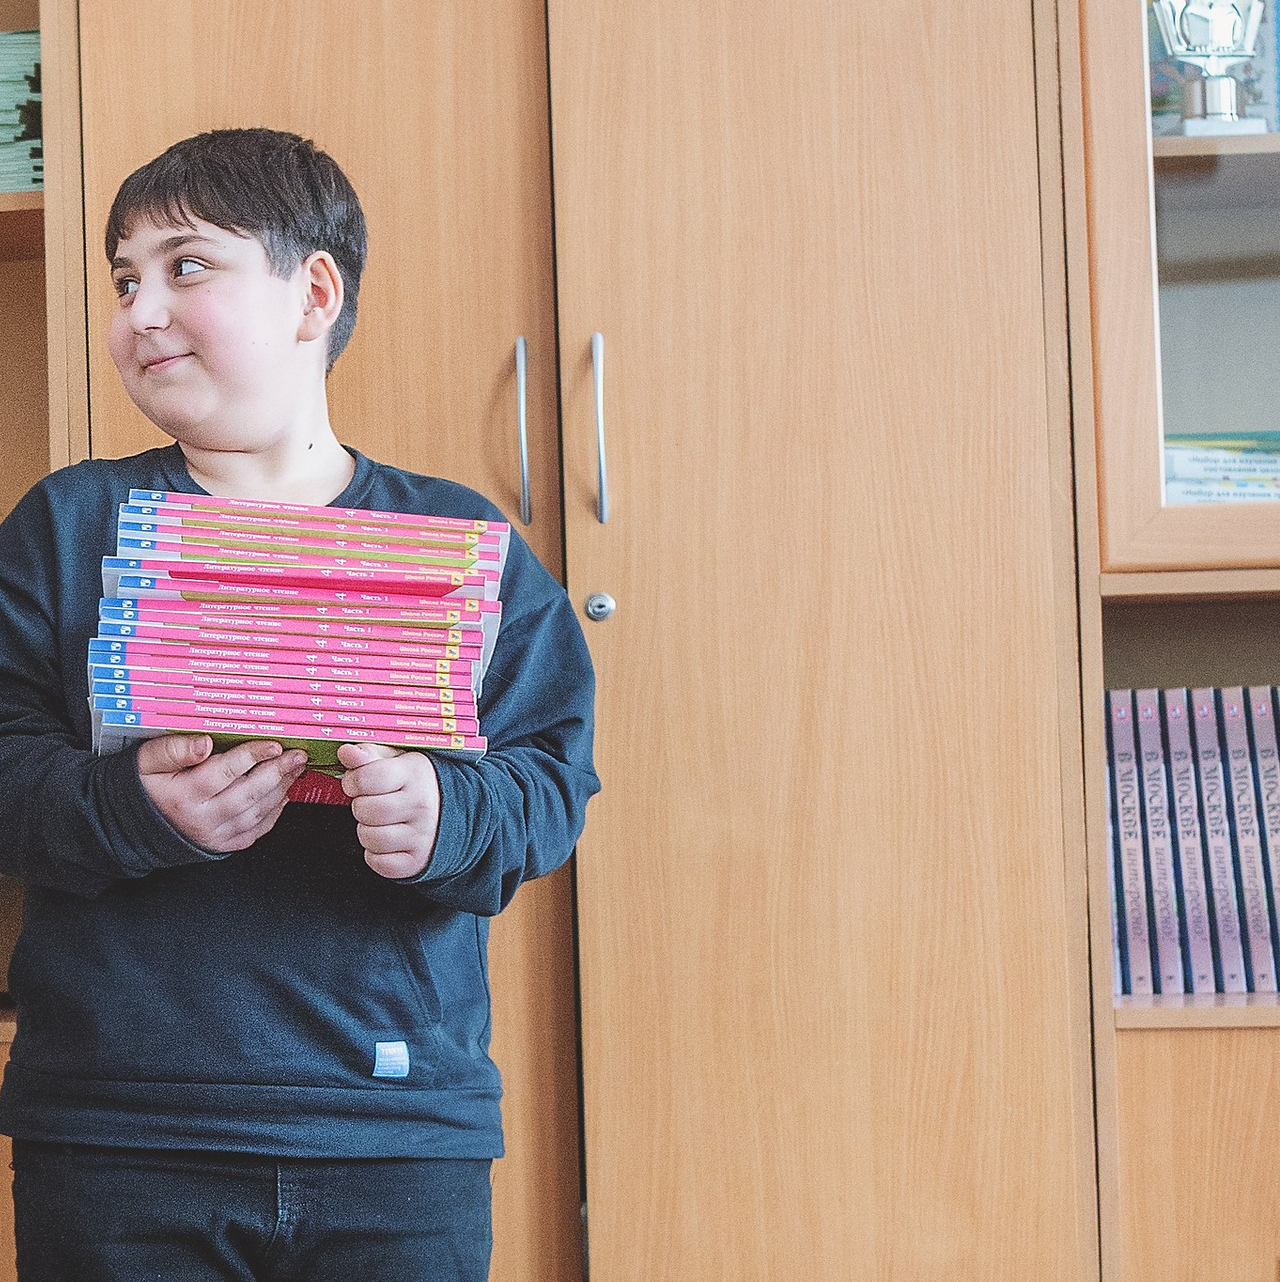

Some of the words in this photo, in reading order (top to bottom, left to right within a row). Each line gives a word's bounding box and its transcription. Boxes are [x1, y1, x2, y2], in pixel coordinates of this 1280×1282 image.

[218, 584, 270, 593] Литературное
[201, 617, 253, 625] Литературное
[198, 632, 250, 640] Литературное
[189, 647, 241, 656] Литературное
[188, 660, 240, 668] Литературное
[305, 667, 317, 675] 4
[192, 675, 244, 684] Литературное
[309, 683, 321, 691] 4
[193, 690, 245, 699] Литературное
[311, 697, 322, 706] 4
[194, 705, 247, 714] Литературное
[313, 713, 324, 721] 4
[203, 720, 256, 729] Литературное
[321, 728, 333, 736] 4
